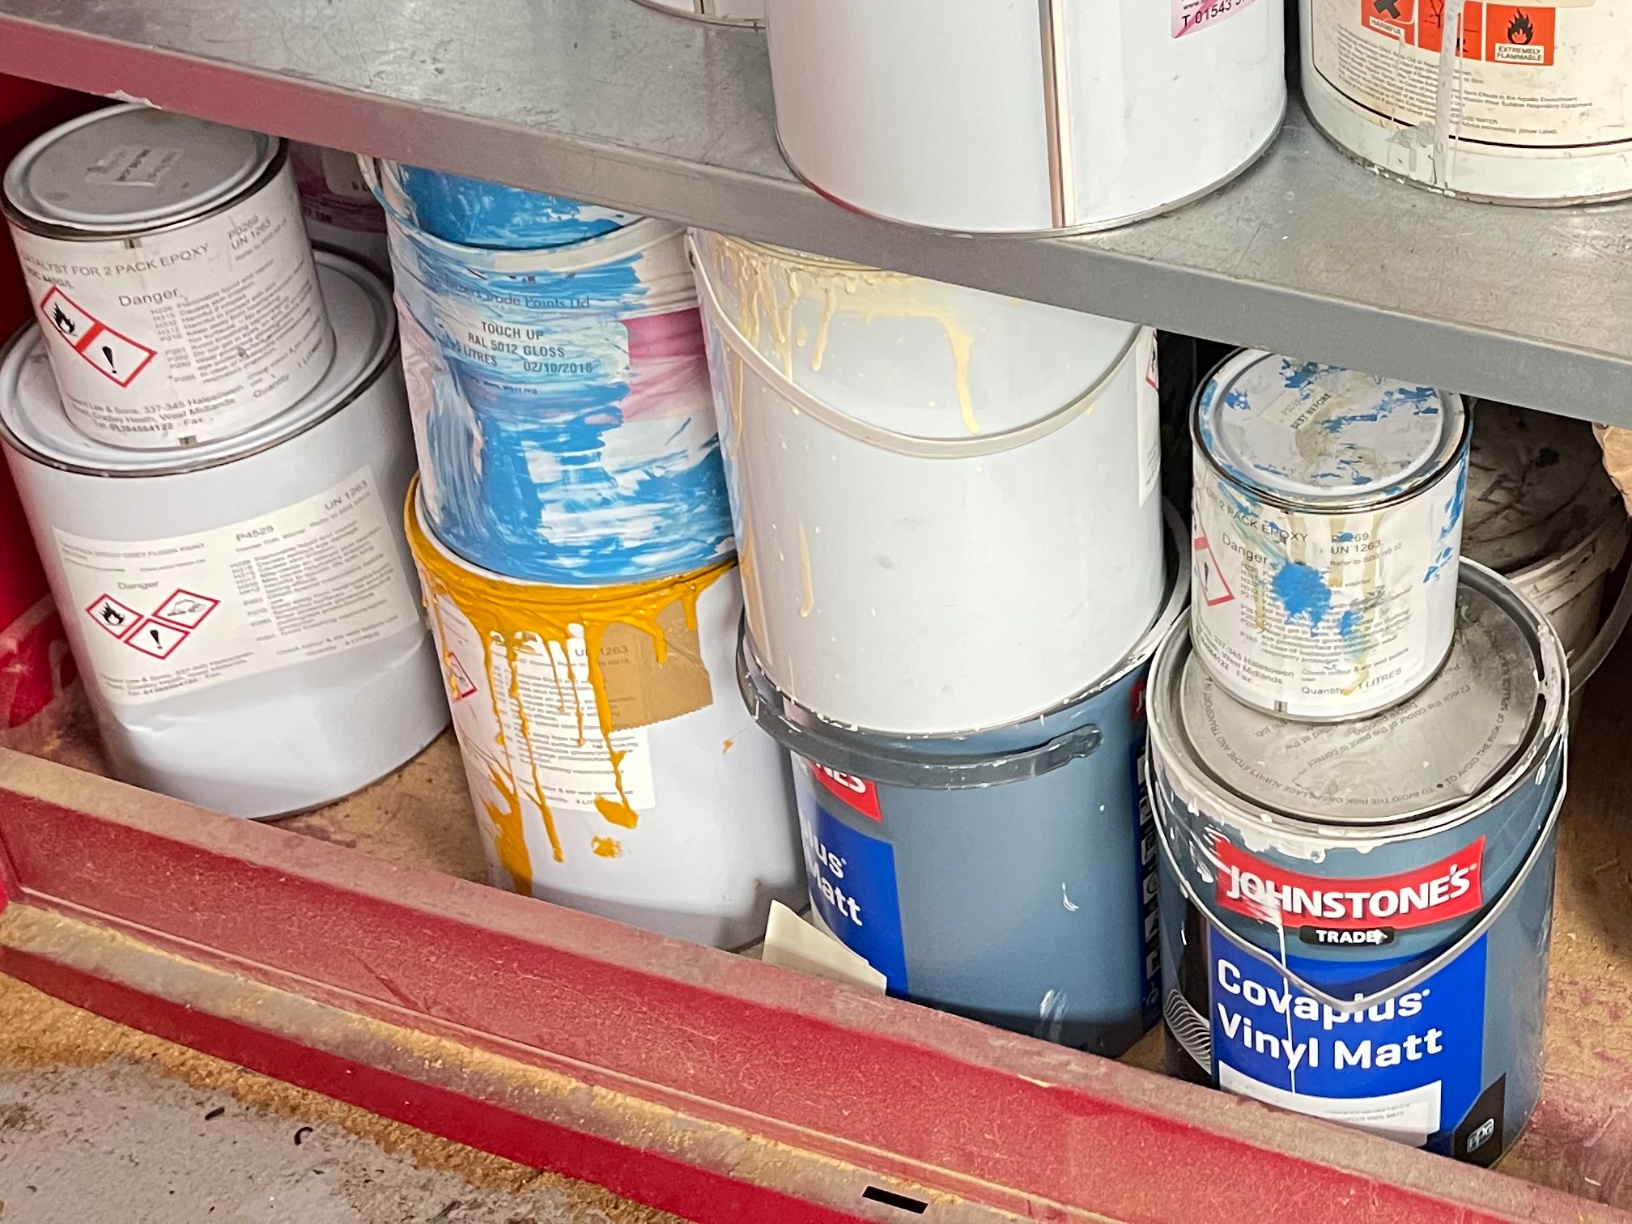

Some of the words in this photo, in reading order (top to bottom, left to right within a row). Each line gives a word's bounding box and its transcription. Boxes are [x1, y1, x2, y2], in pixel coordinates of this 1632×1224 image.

[1181, 14, 1191, 28] T
[1497, 52, 1543, 62] FLAMMABLE
[1498, 45, 1541, 55] EXTREMELY
[72, 265, 101, 276] FOR
[103, 266, 113, 276] 2
[116, 260, 157, 275] PACK
[160, 242, 210, 267] EPOXY
[119, 287, 179, 307] Danger
[481, 321, 521, 339] TOUCH
[527, 329, 544, 340] UP
[468, 332, 488, 349] RAL
[491, 339, 518, 355] 5012
[524, 345, 565, 358] GLOSS
[464, 346, 497, 367] LITRES
[524, 361, 594, 374] 02/10/2018
[1227, 506, 1258, 529] PACK
[1261, 524, 1309, 543] EPOXY
[1222, 532, 1269, 565] Danger
[1331, 545, 1349, 555] UN
[1354, 540, 1381, 553] 1263
[1301, 686, 1344, 696] Quantity
[1365, 667, 1402, 689] LITRES
[1427, 699, 1442, 710] the
[1399, 706, 1427, 725] colour
[1372, 725, 1388, 737] the
[1389, 720, 1398, 731] of
[1348, 732, 1372, 747] paint
[1306, 748, 1339, 768] correct
[1346, 797, 1369, 805] RISK
[1370, 797, 1390, 805] THE
[1392, 791, 1420, 802] AVOID
[1226, 864, 1471, 920] JOHNSTONE'S
[1315, 929, 1384, 945] TRADE
[1217, 959, 1424, 1030] Covaplus
[1216, 1002, 1320, 1071] Vinyl
[1335, 1027, 1443, 1070] Matt
